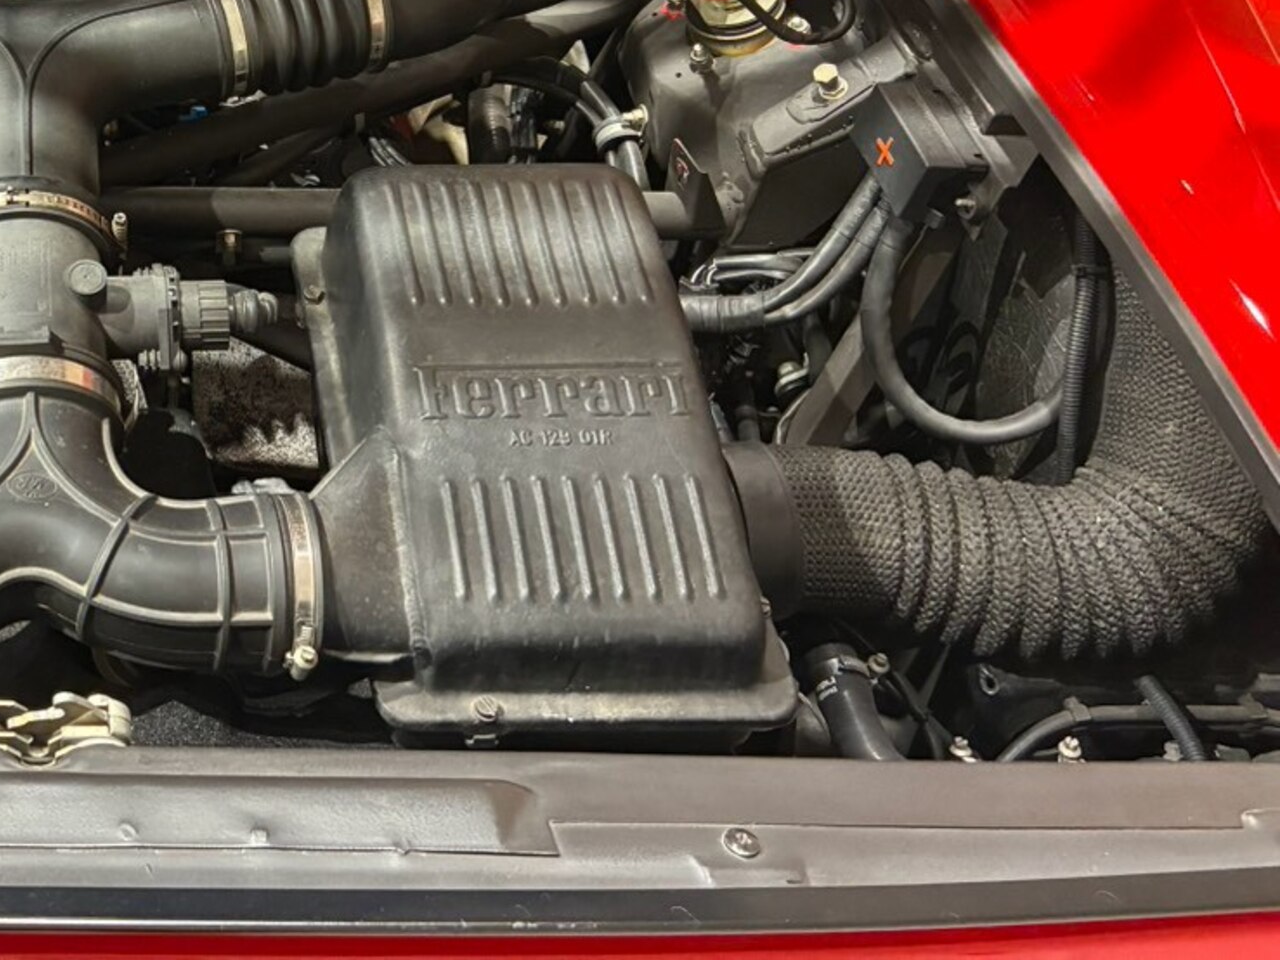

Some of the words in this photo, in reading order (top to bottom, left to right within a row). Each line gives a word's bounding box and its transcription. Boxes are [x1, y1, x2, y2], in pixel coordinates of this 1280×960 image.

[875, 137, 894, 167] X
[414, 363, 692, 420] Ferrari
[509, 429, 533, 446] AC
[541, 429, 573, 446] 129
